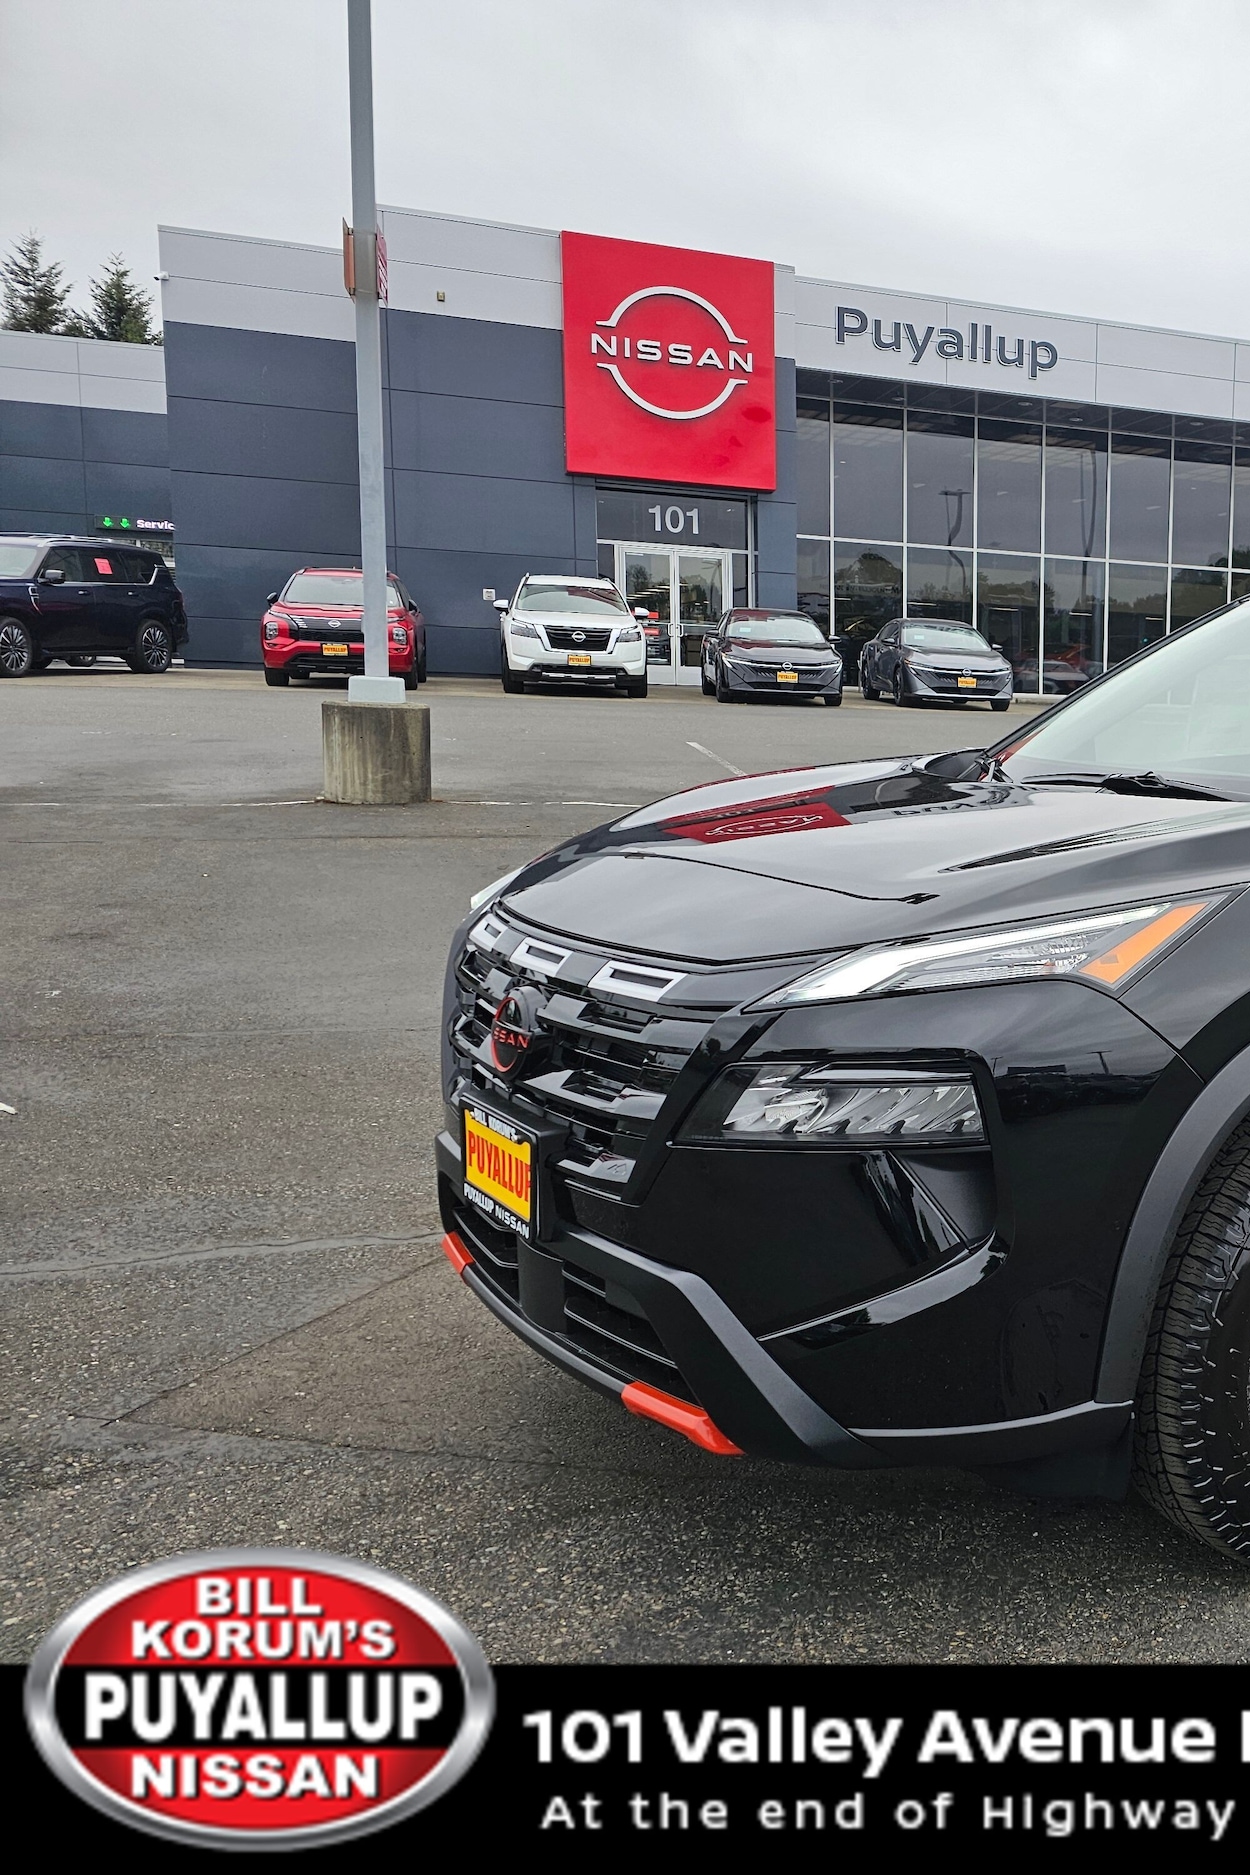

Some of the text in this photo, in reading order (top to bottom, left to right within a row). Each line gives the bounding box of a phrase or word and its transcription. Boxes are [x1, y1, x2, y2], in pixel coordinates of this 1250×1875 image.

[591, 332, 753, 373] NISSAN
[836, 305, 1058, 380] Puyallup
[648, 505, 700, 535] 101
[463, 1182, 530, 1239] PUYALLUP NISSAN
